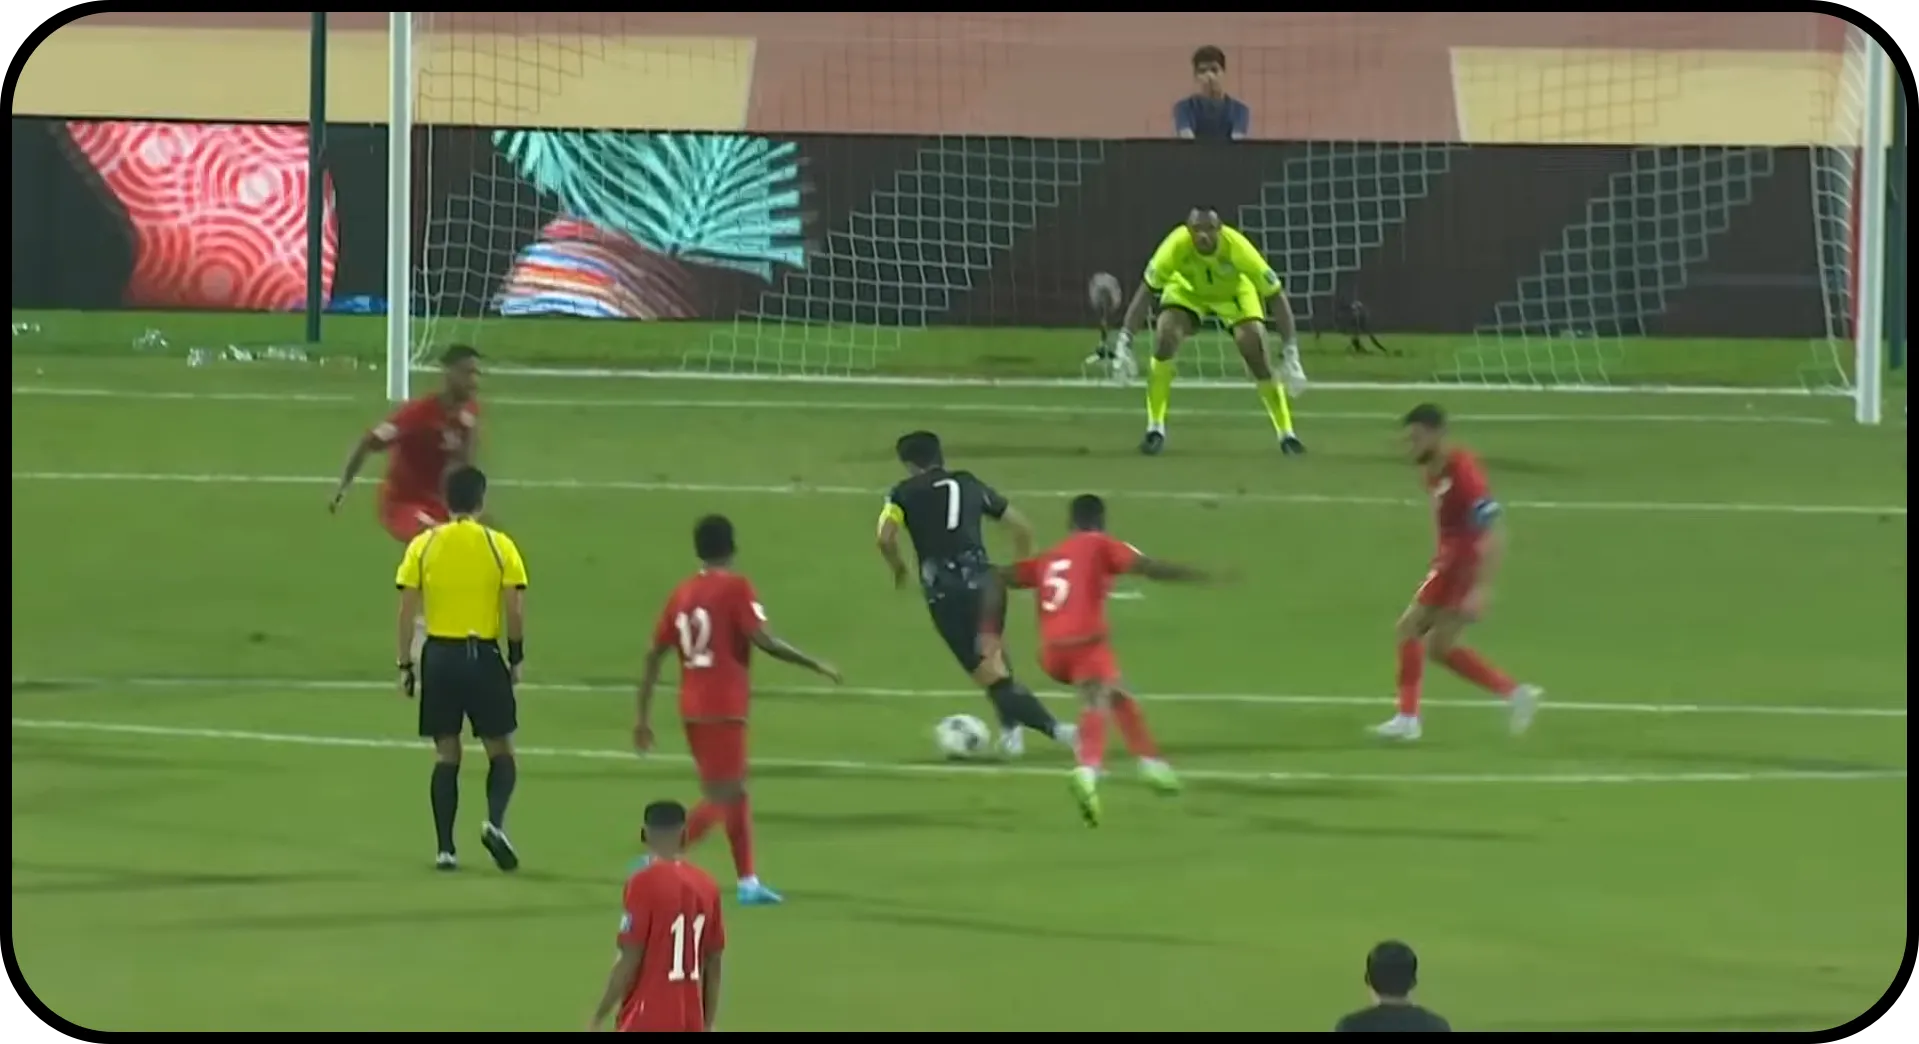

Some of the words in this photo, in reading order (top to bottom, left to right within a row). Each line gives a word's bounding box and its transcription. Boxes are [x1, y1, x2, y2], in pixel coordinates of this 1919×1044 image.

[932, 478, 960, 530] 7
[1042, 559, 1072, 612] 5
[675, 606, 713, 669] 12
[668, 912, 706, 981] 11
